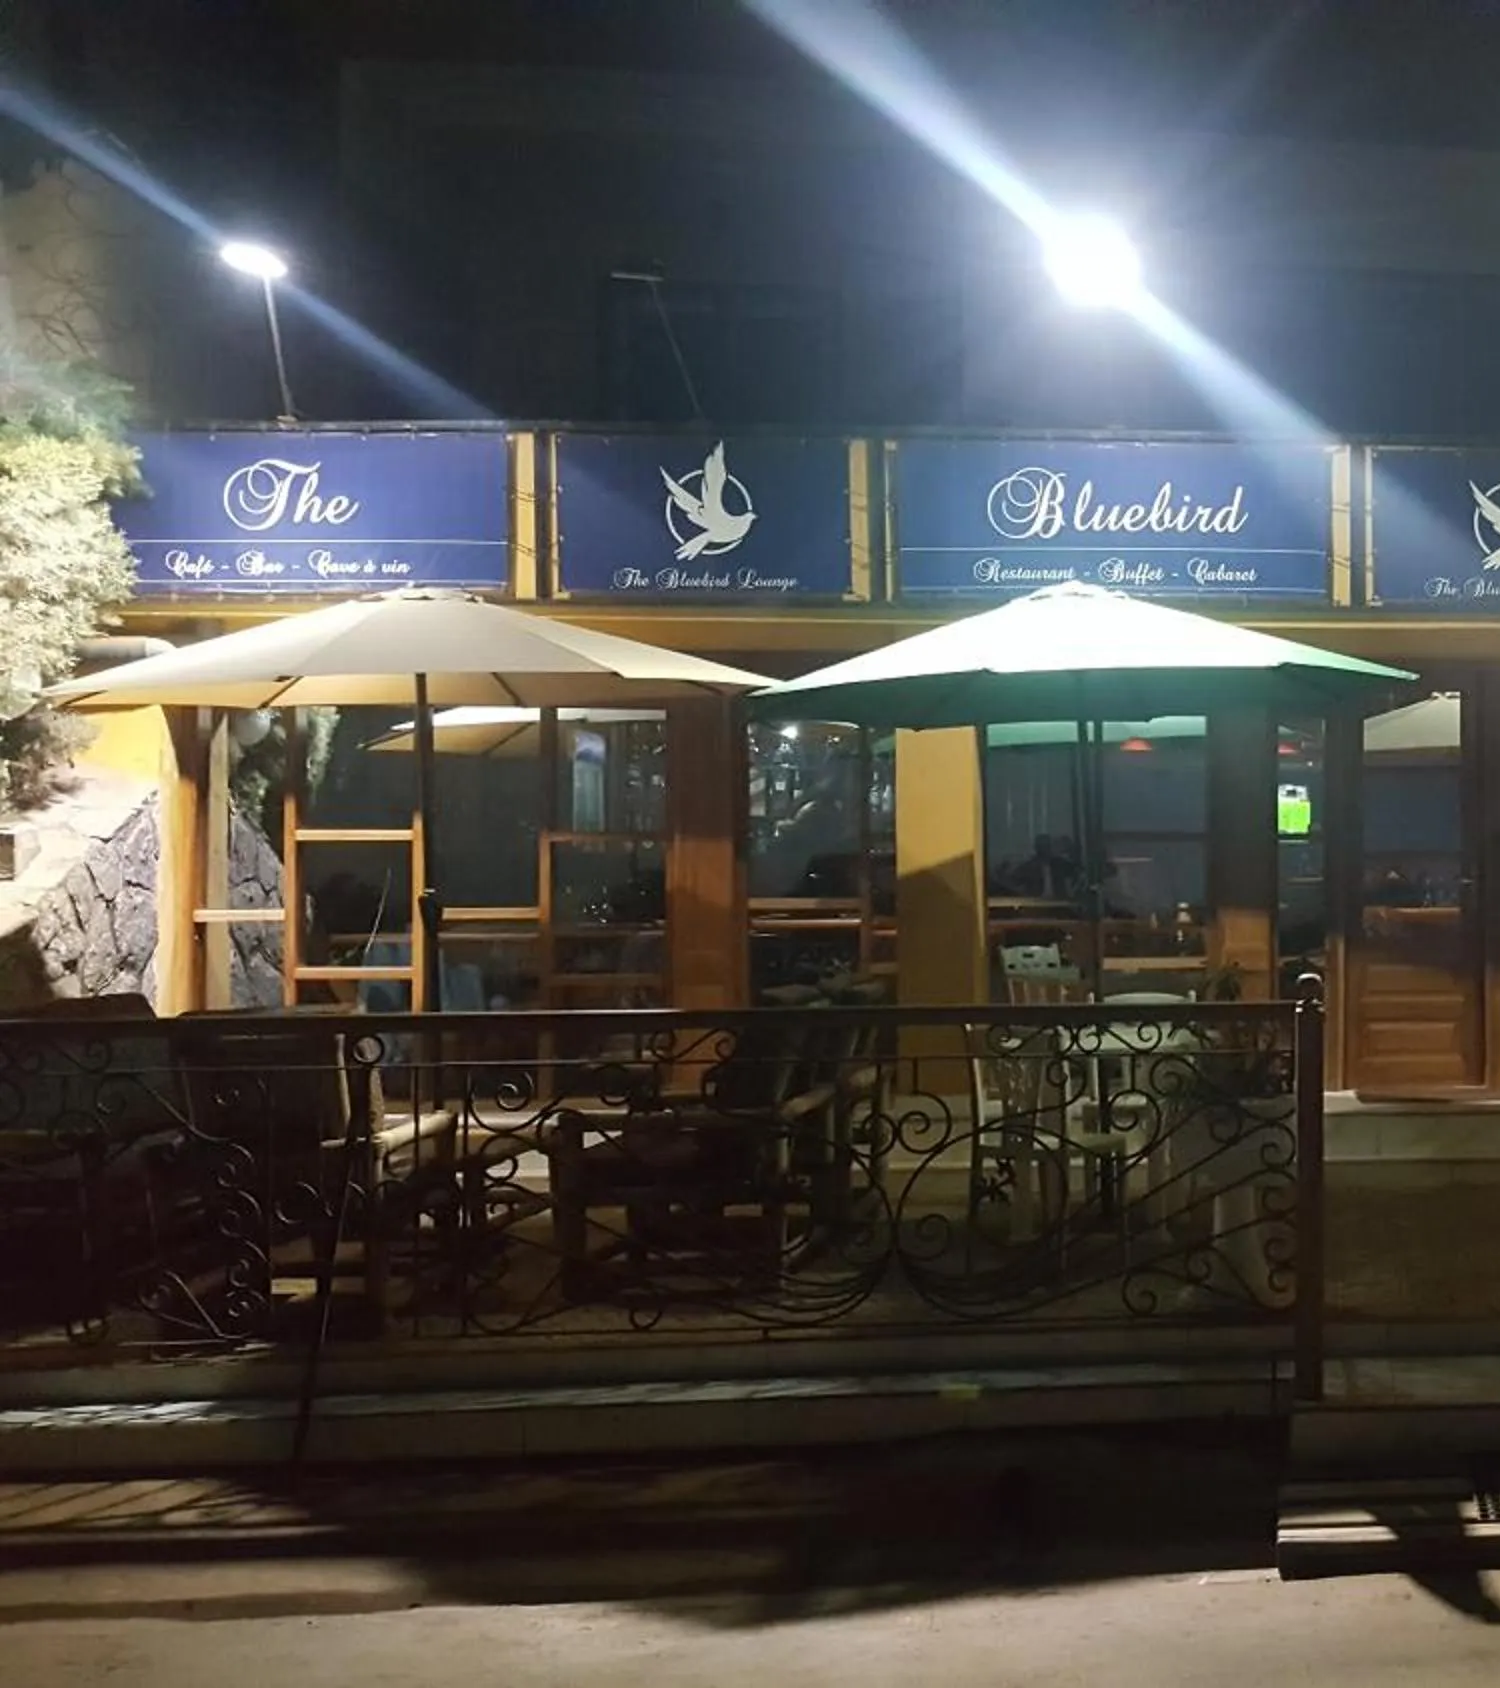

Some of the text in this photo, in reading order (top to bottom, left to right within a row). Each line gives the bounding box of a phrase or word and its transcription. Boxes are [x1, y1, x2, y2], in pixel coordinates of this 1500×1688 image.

[223, 458, 359, 531] The
[987, 466, 1249, 539] Bluebird
[613, 567, 799, 592] The Bluebird Lounge
[973, 557, 1076, 583] Restaurant
[1099, 557, 1164, 586] Buffet
[1187, 557, 1258, 584] Cabaret
[1424, 577, 1459, 598] The
